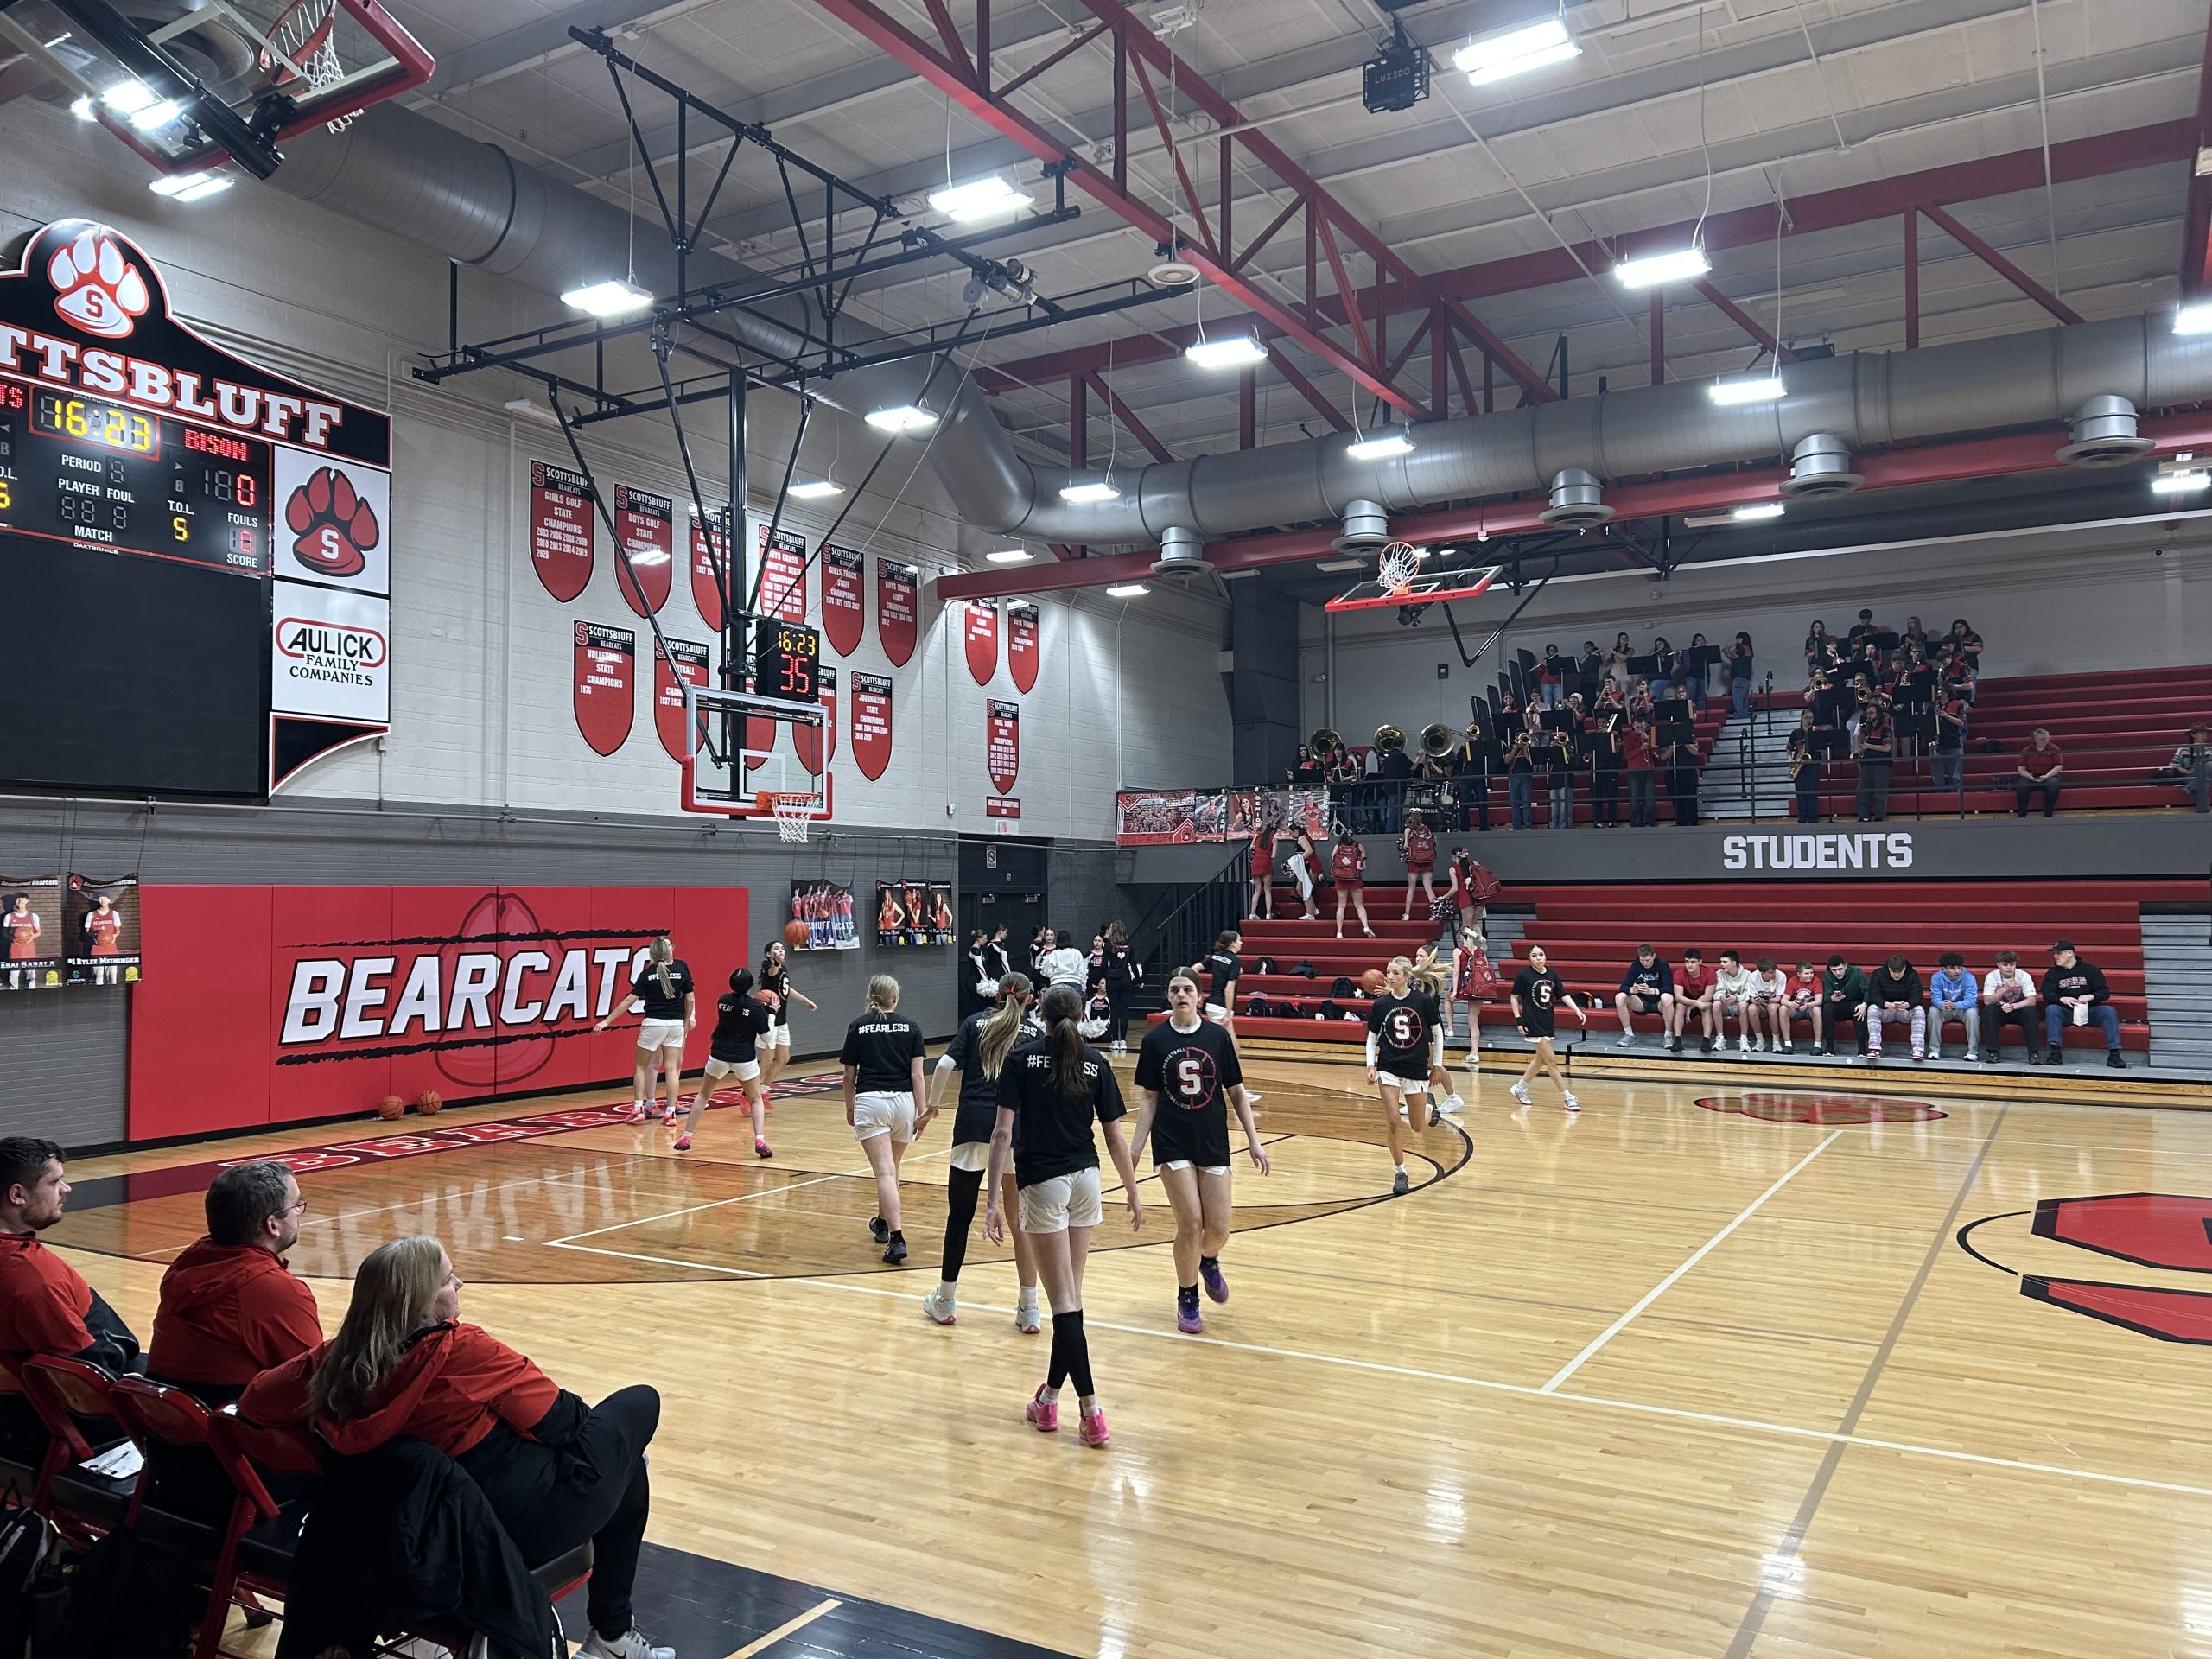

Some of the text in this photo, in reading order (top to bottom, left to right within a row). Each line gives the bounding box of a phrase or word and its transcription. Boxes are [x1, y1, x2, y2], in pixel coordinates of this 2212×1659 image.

[1375, 67, 1411, 84] LUXEDO
[86, 290, 104, 318] S
[54, 399, 150, 451] 16:23
[184, 428, 250, 462] BISON
[61, 454, 102, 473] PERIOD
[532, 461, 546, 486] S
[546, 467, 588, 487] SCOTTSBLUF
[57, 477, 135, 504] PLAYER FOUL
[557, 482, 582, 496] BEARCATS
[616, 486, 629, 510] S
[167, 499, 195, 516] T.O.L.
[544, 491, 582, 509] GIRLS GOLF
[629, 490, 671, 510] SCOTTSBLUFF
[227, 512, 258, 528] FOULS
[553, 506, 573, 519] STATE
[628, 512, 661, 529] BOYS GOLF
[74, 524, 113, 543] MATCH
[543, 517, 582, 535] CHAMPIONS
[635, 527, 653, 540] STATE
[73, 543, 119, 555] DAKTRONICS
[321, 527, 340, 560] S
[226, 553, 258, 569] SCORE
[836, 578, 850, 589] STATE
[575, 621, 588, 645] S
[588, 625, 633, 642] SCOTTSBLUFF
[287, 627, 374, 660] AULICK
[600, 639, 622, 651] BEARCATS
[667, 640, 708, 656] SCOTTSBLUFF
[779, 631, 817, 657] 16:23
[305, 653, 359, 671] FAMILY
[595, 663, 614, 675] STATE
[289, 665, 374, 687] COMPANIES
[587, 674, 623, 689] CHAMPIONS
[780, 653, 810, 693] 35
[861, 675, 892, 688] SCOTTSBLUFF
[1723, 832, 1913, 869] STUDENTS
[1541, 985, 1552, 1003] S
[858, 1022, 910, 1036] #FEARLESS
[1394, 1015, 1410, 1039] S
[1027, 1054, 1099, 1077] #FESS
[1178, 1059, 1202, 1095] S
